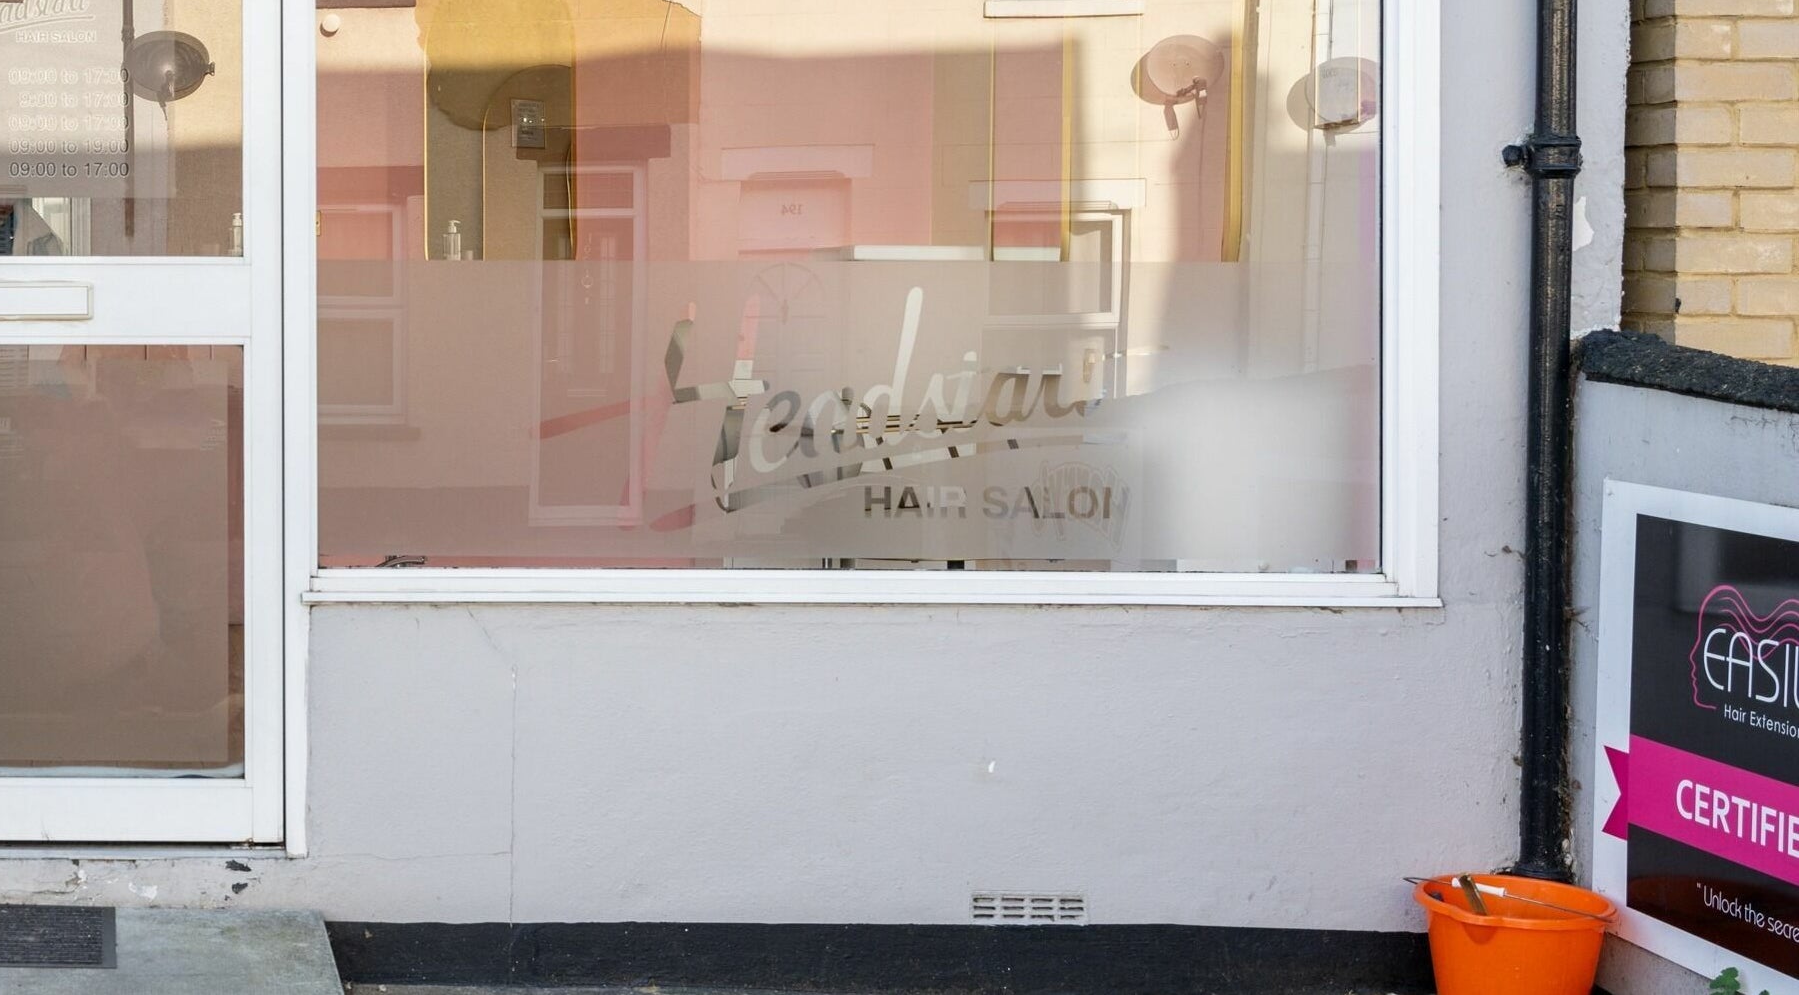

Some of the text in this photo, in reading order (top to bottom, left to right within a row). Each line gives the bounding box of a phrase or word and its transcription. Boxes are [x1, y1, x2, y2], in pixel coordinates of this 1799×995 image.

[15, 30, 96, 43] HAIR SALON
[62, 67, 79, 84] to
[62, 91, 79, 108] to
[62, 115, 79, 132] to
[8, 139, 57, 154] 09:00
[62, 139, 79, 154] to
[83, 139, 130, 154] 19:00
[8, 162, 57, 177] 09:00
[62, 162, 79, 177] to
[83, 162, 130, 177] 17:00
[864, 485, 1128, 521] HAIR SALON
[1724, 703, 1746, 724] Hair
[1744, 903, 1765, 930] the
